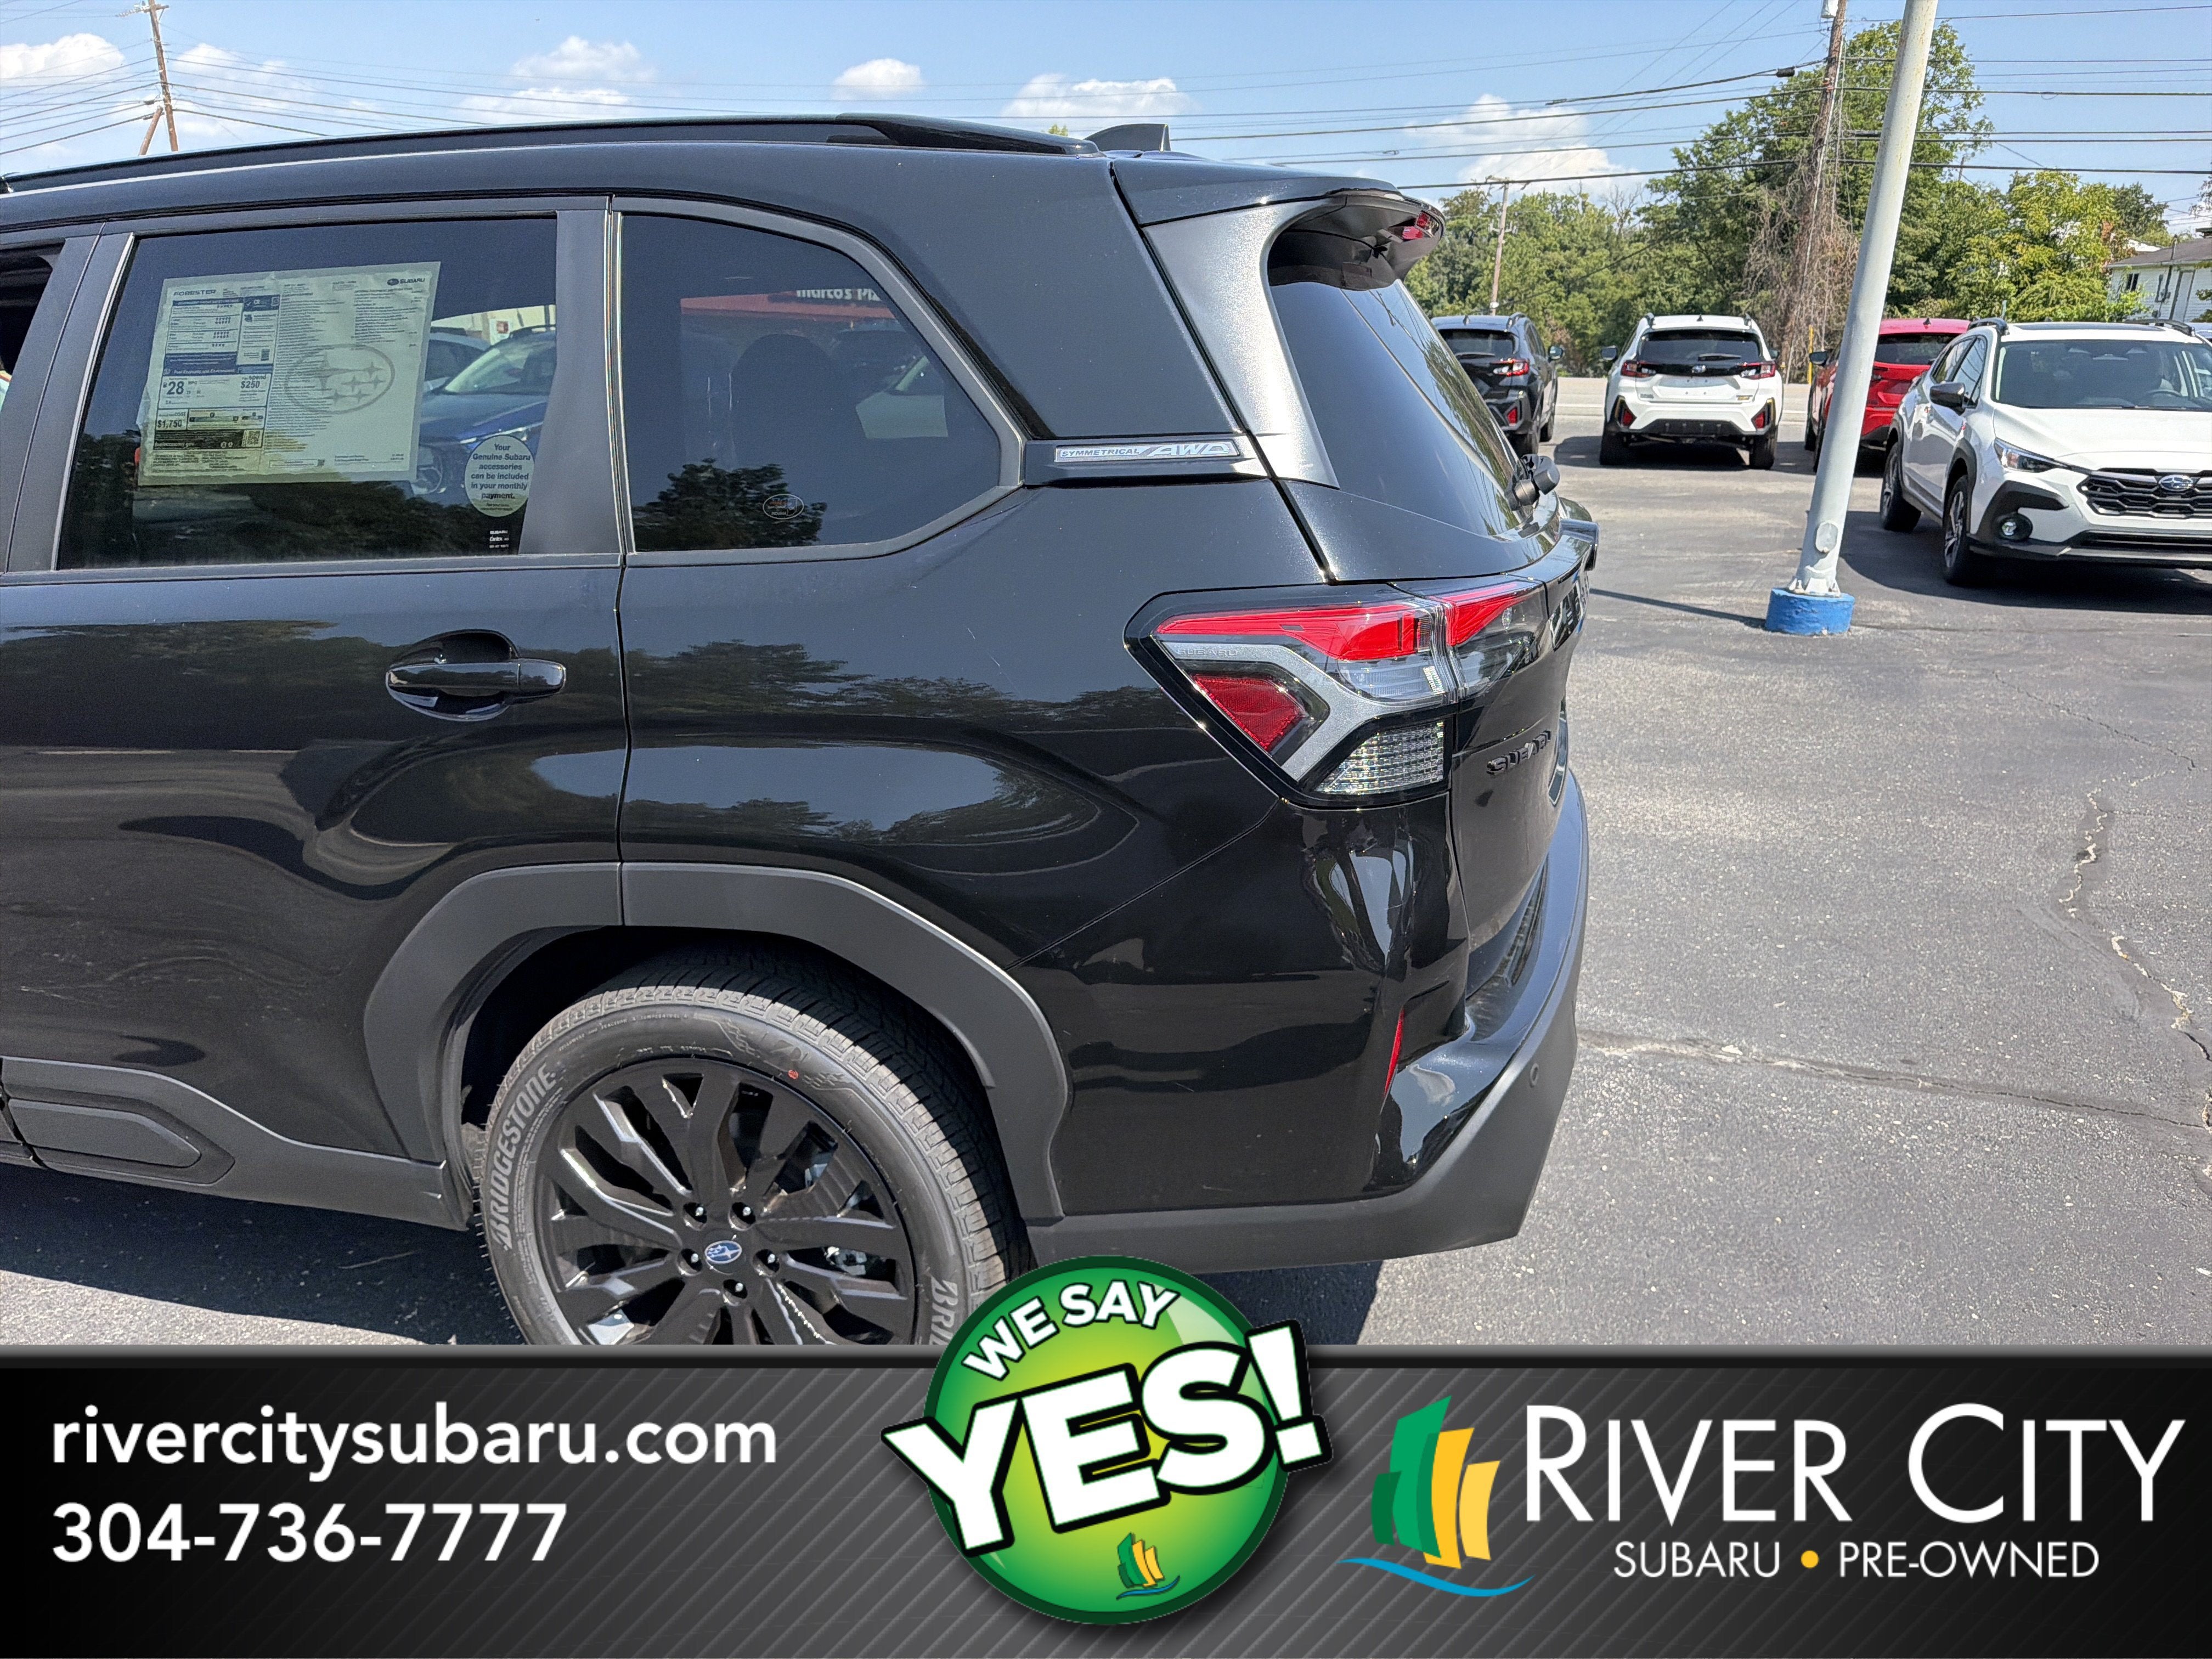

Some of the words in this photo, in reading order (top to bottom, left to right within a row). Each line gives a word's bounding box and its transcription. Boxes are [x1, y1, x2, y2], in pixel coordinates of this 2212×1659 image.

[166, 381, 185, 395] 28
[240, 380, 261, 388] $250
[157, 419, 183, 428] $1,750
[1062, 448, 1140, 458] SYMMETRICAL
[1147, 442, 1231, 458] AWD
[497, 482, 528, 490] monthly
[1176, 647, 1240, 657] SUBARU
[490, 1062, 557, 1250] BRIDGESTONE
